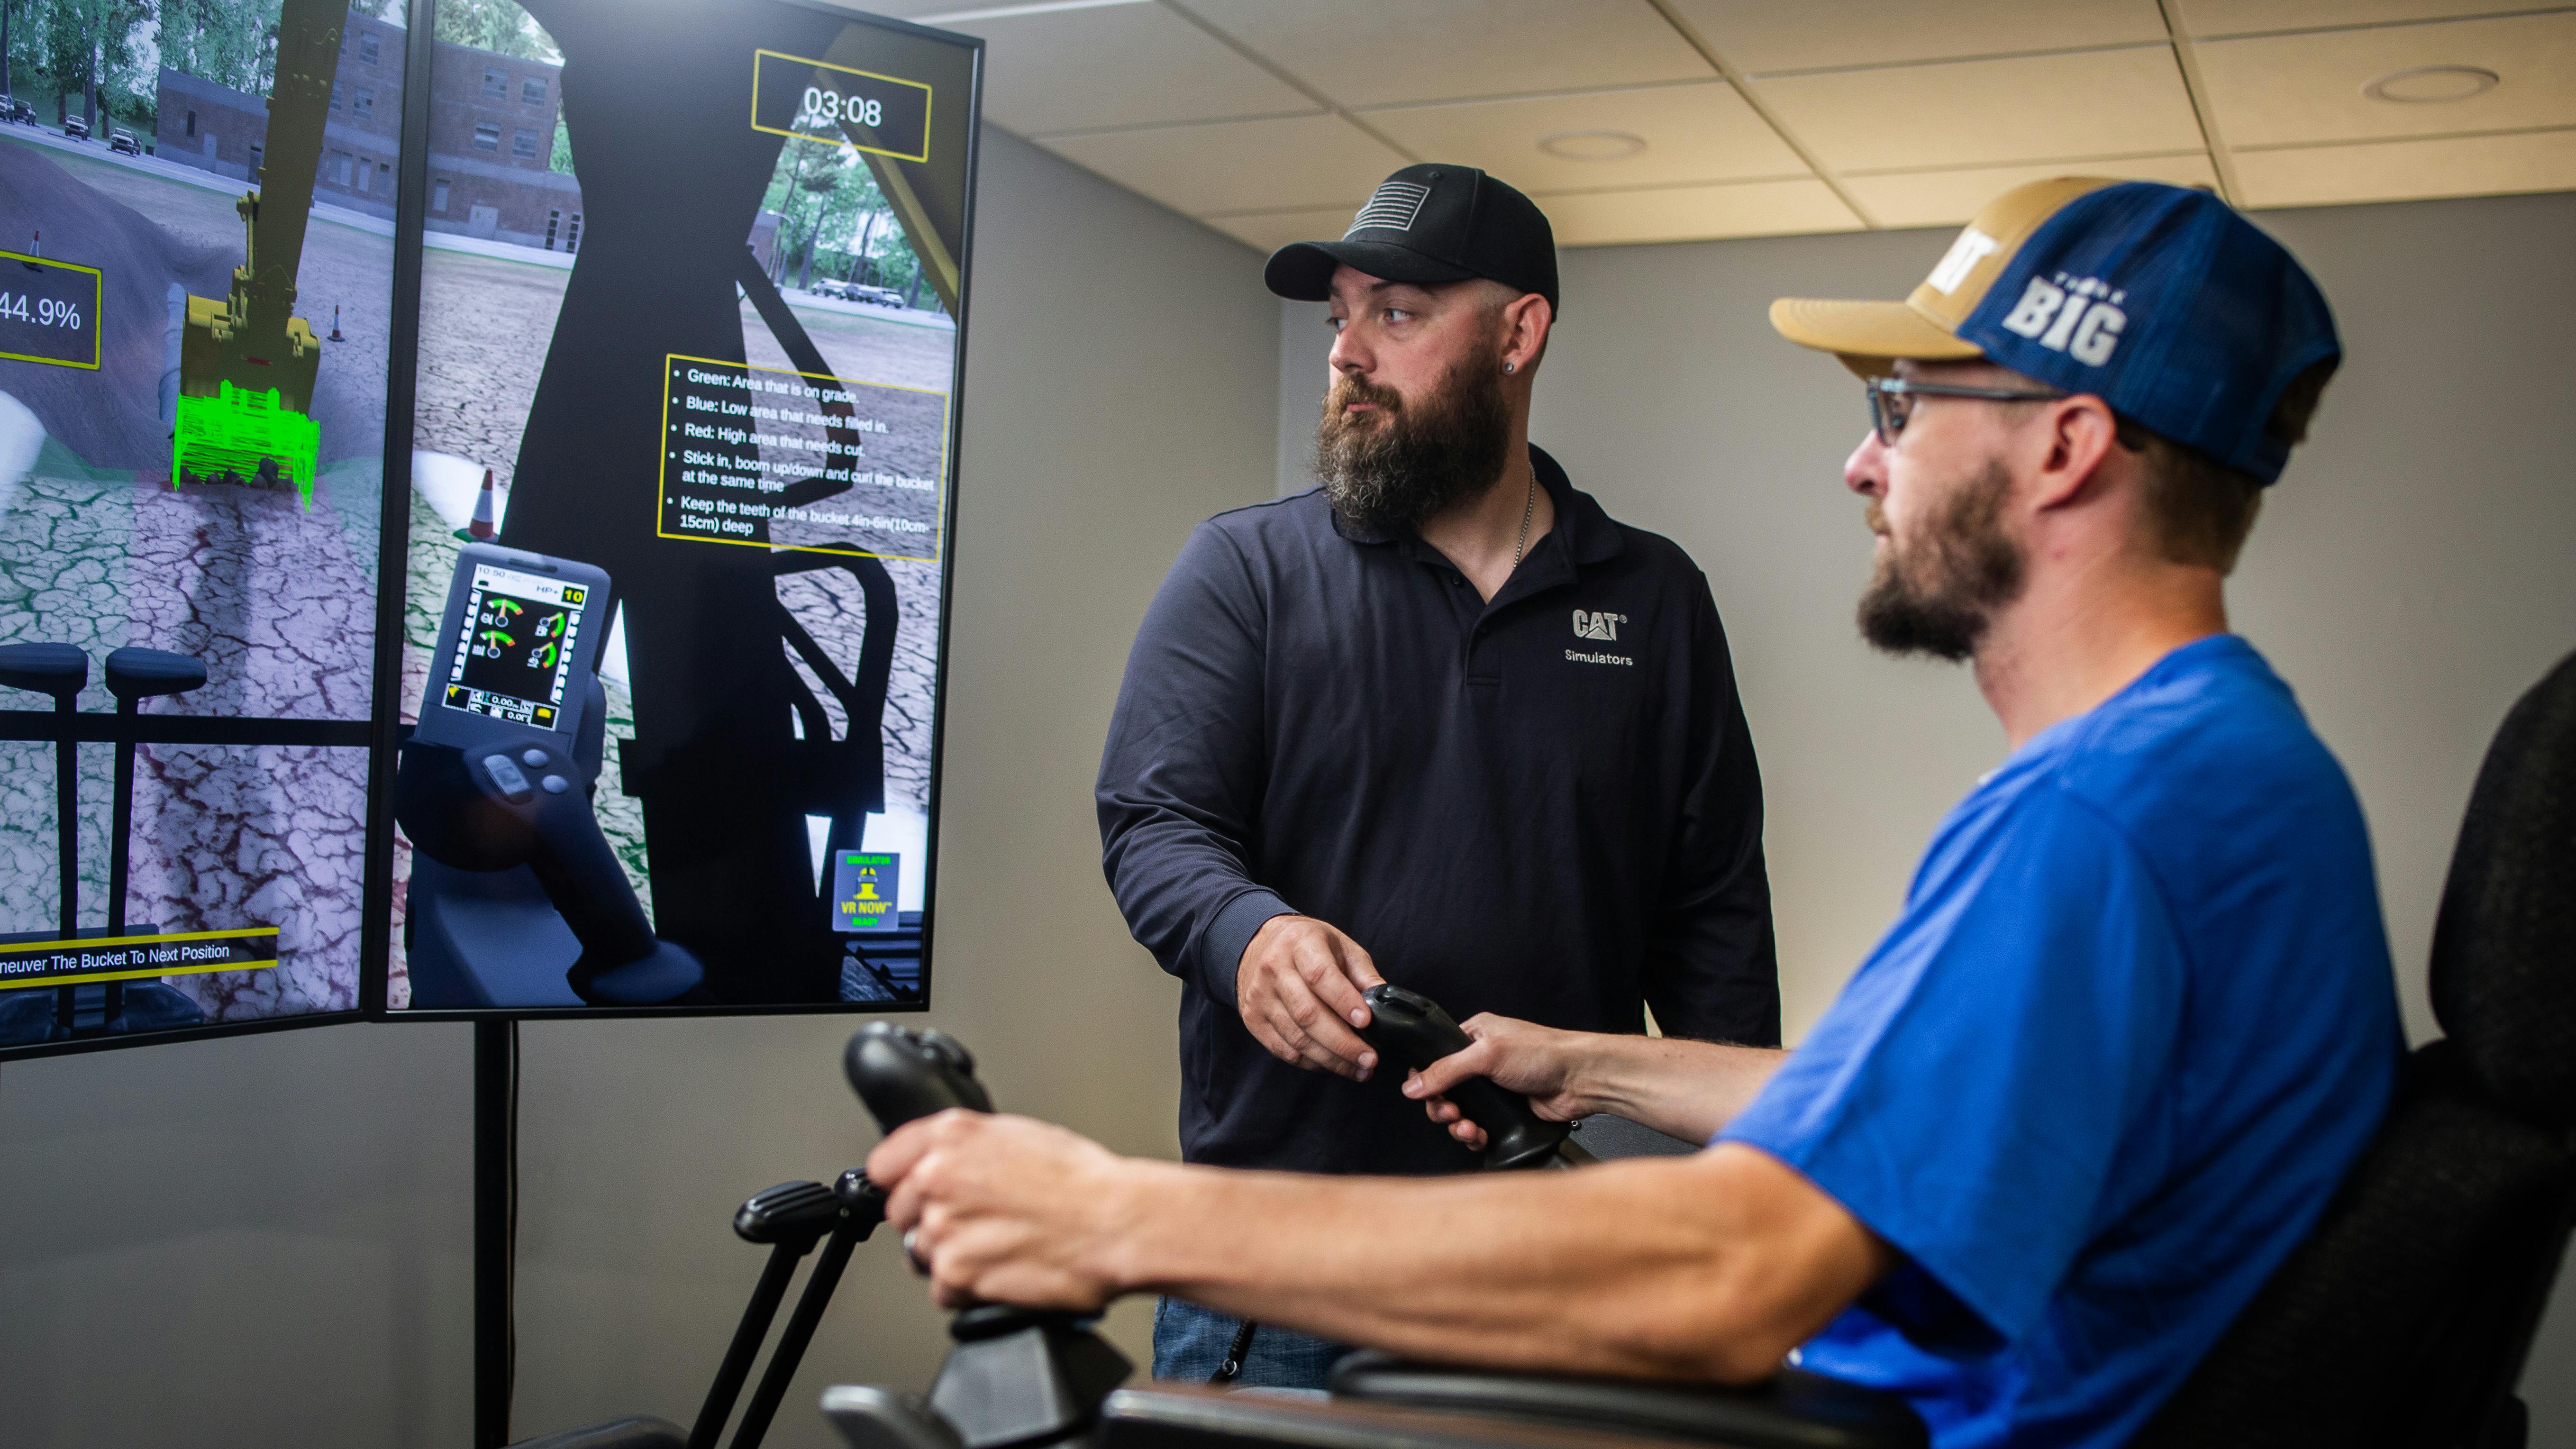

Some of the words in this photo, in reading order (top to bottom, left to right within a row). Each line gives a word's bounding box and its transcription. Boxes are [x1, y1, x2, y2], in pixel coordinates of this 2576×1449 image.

[804, 87, 882, 127] 03:08
[0, 292, 81, 330] 44.9%
[2002, 275, 2128, 367] BIG
[687, 368, 731, 387] Green:
[732, 374, 763, 391] Area
[765, 380, 788, 394] that
[791, 383, 801, 396] is
[804, 386, 819, 398] on
[822, 389, 859, 403] grade.
[686, 395, 719, 412] Blue:
[721, 400, 748, 416] Low
[749, 406, 777, 419] area
[780, 408, 803, 423] that
[805, 414, 843, 428] needs
[845, 415, 873, 431] filled
[874, 419, 889, 434] in.
[685, 422, 715, 439] Red:
[718, 427, 747, 445] High
[749, 432, 777, 446] area
[780, 434, 803, 449] that
[805, 440, 842, 455] needs
[844, 444, 865, 457] cut.
[682, 470, 695, 483] at
[698, 470, 718, 485] the
[720, 474, 755, 489] same
[757, 478, 784, 492] time
[683, 449, 715, 466] Stick
[717, 453, 732, 470] in,
[735, 455, 770, 472] boom
[772, 461, 823, 478] up/down
[825, 468, 849, 482] and
[851, 472, 873, 483] curl
[874, 473, 894, 487] the
[895, 476, 934, 491] bucket
[680, 514, 719, 534] 15cm)
[722, 518, 754, 537] deep
[681, 495, 714, 515] Keep
[717, 499, 737, 514] the
[739, 501, 770, 518] teeth
[773, 505, 786, 519] of
[788, 506, 807, 521] the
[810, 509, 849, 526] bucket
[564, 589, 583, 603] 10
[1565, 648, 1634, 666] Simulators
[841, 902, 856, 914] VR
[51, 955, 77, 970] The
[81, 951, 127, 968] Bucket
[130, 950, 145, 964] To
[149, 948, 178, 963] Next
[182, 944, 229, 960] Position
